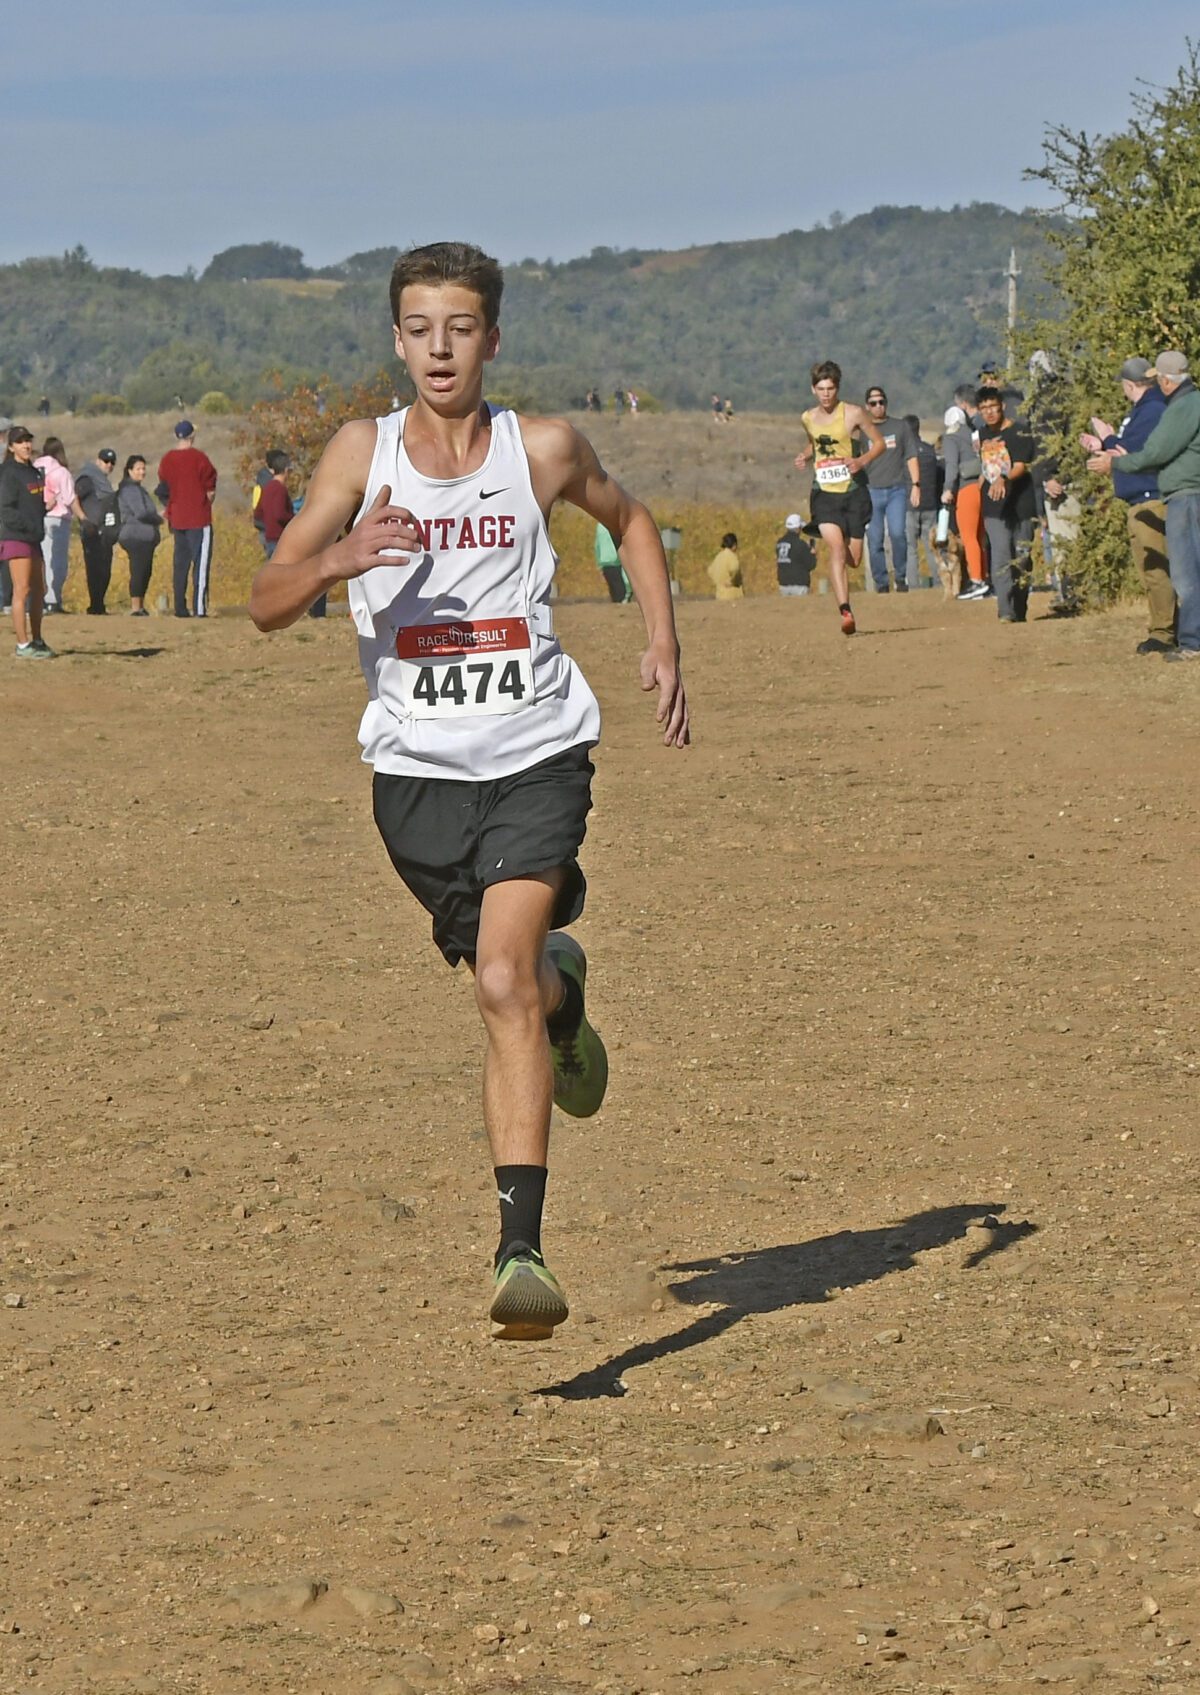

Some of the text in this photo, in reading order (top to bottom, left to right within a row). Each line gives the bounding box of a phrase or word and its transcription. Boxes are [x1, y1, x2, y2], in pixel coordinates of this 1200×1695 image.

[820, 467, 848, 480] 4364
[380, 515, 516, 552] NTAGE
[417, 628, 508, 647] RACE RESULT
[412, 659, 526, 707] 4474
